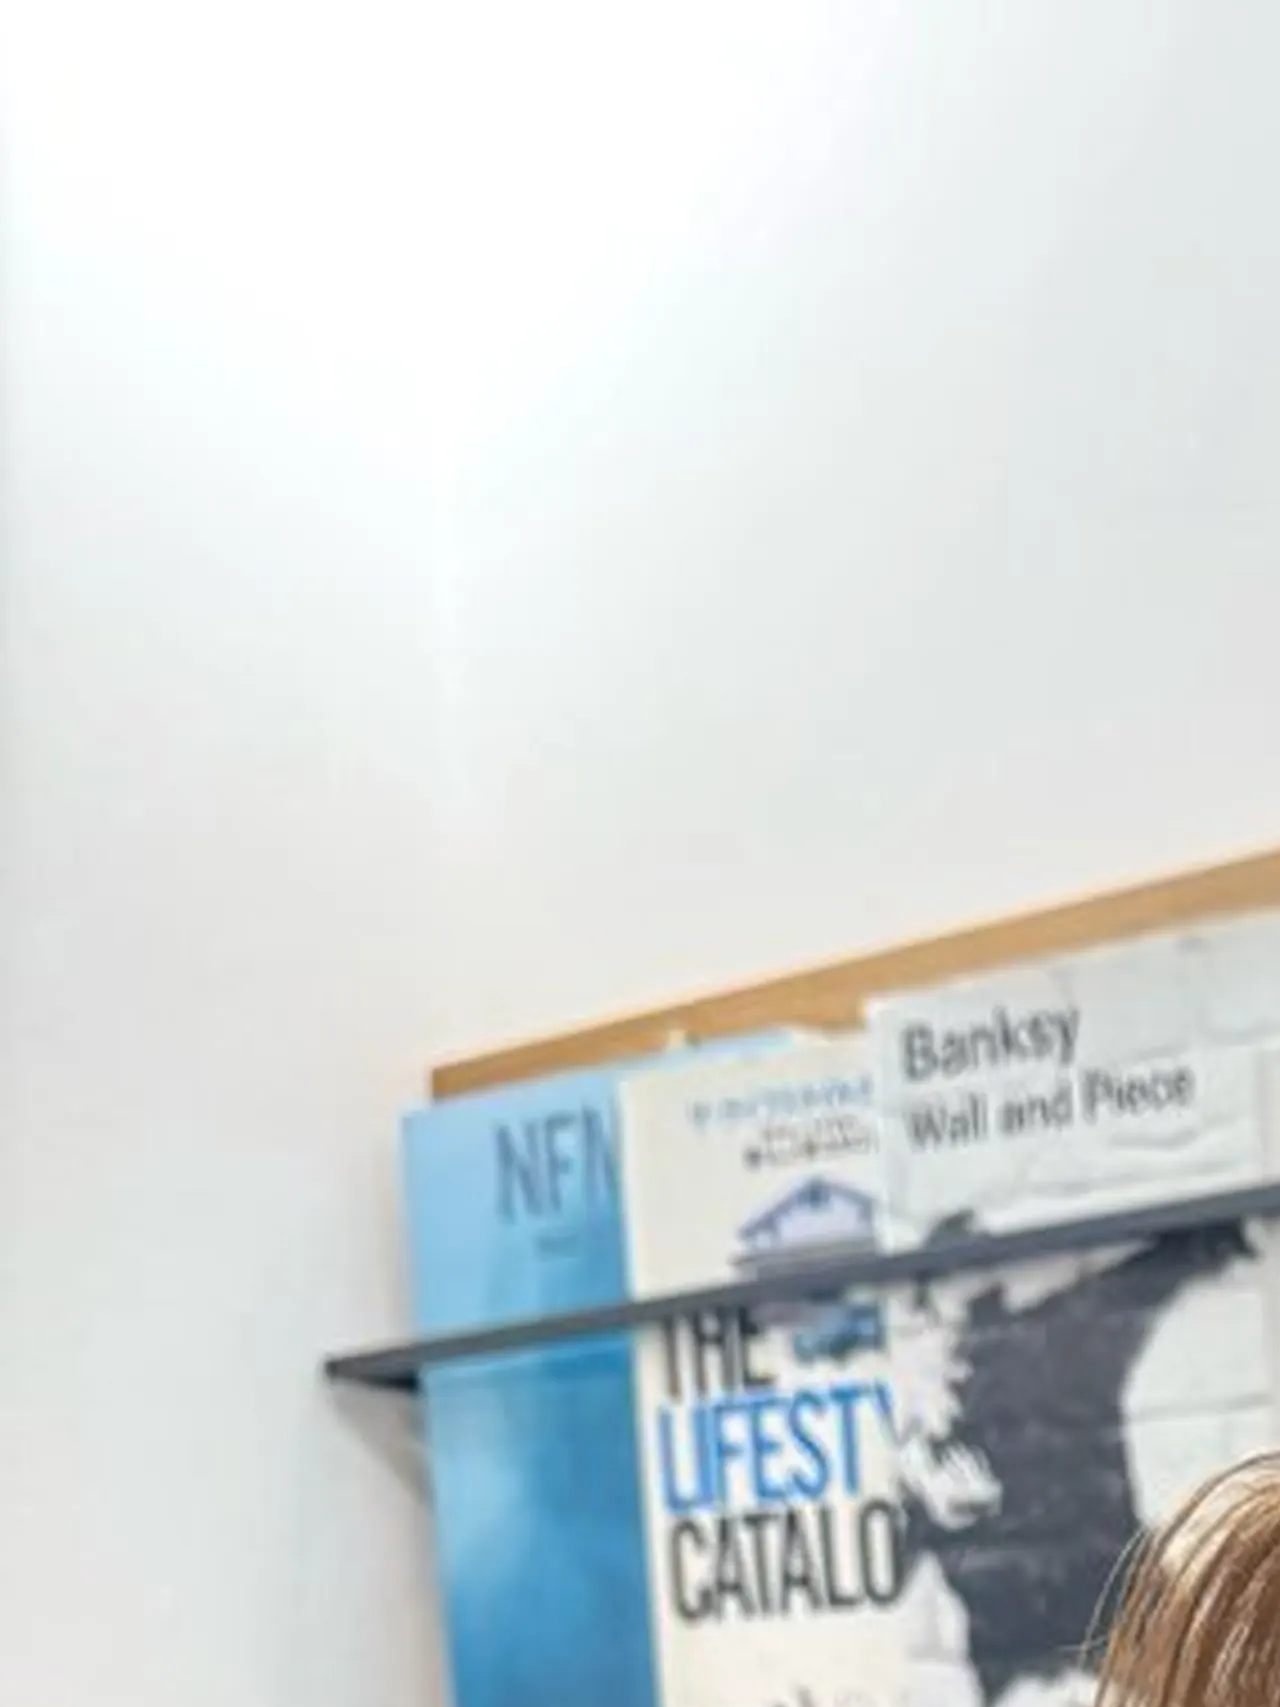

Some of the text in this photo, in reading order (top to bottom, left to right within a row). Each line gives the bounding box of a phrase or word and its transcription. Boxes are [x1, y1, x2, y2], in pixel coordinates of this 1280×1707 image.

[900, 1003, 1082, 1082] Banksy
[908, 1098, 990, 1152] Wall
[999, 1085, 1073, 1135] and
[1083, 1062, 1197, 1121] Piece
